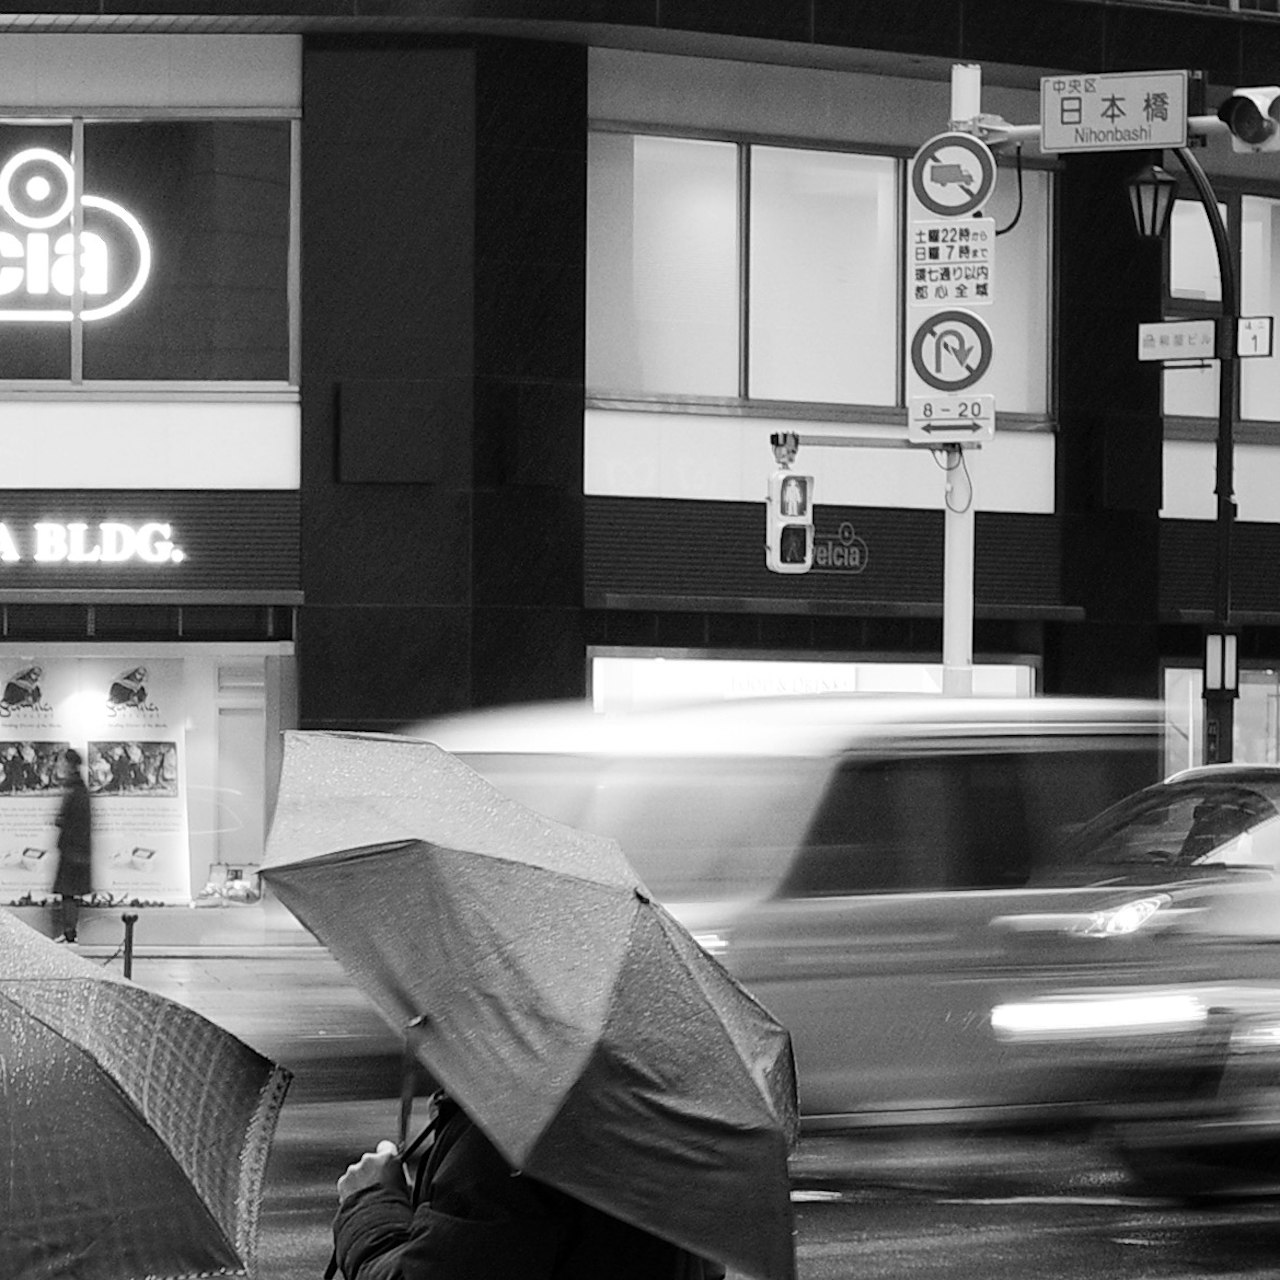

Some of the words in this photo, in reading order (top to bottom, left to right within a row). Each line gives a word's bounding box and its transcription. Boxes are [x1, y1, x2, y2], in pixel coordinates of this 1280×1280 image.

[1052, 78, 1097, 94] 中央区
[1060, 92, 1169, 125] 日本橋
[1074, 124, 1153, 143] Nihonbashi
[1251, 334, 1258, 353] 1
[34, 522, 185, 562] BLDG.
